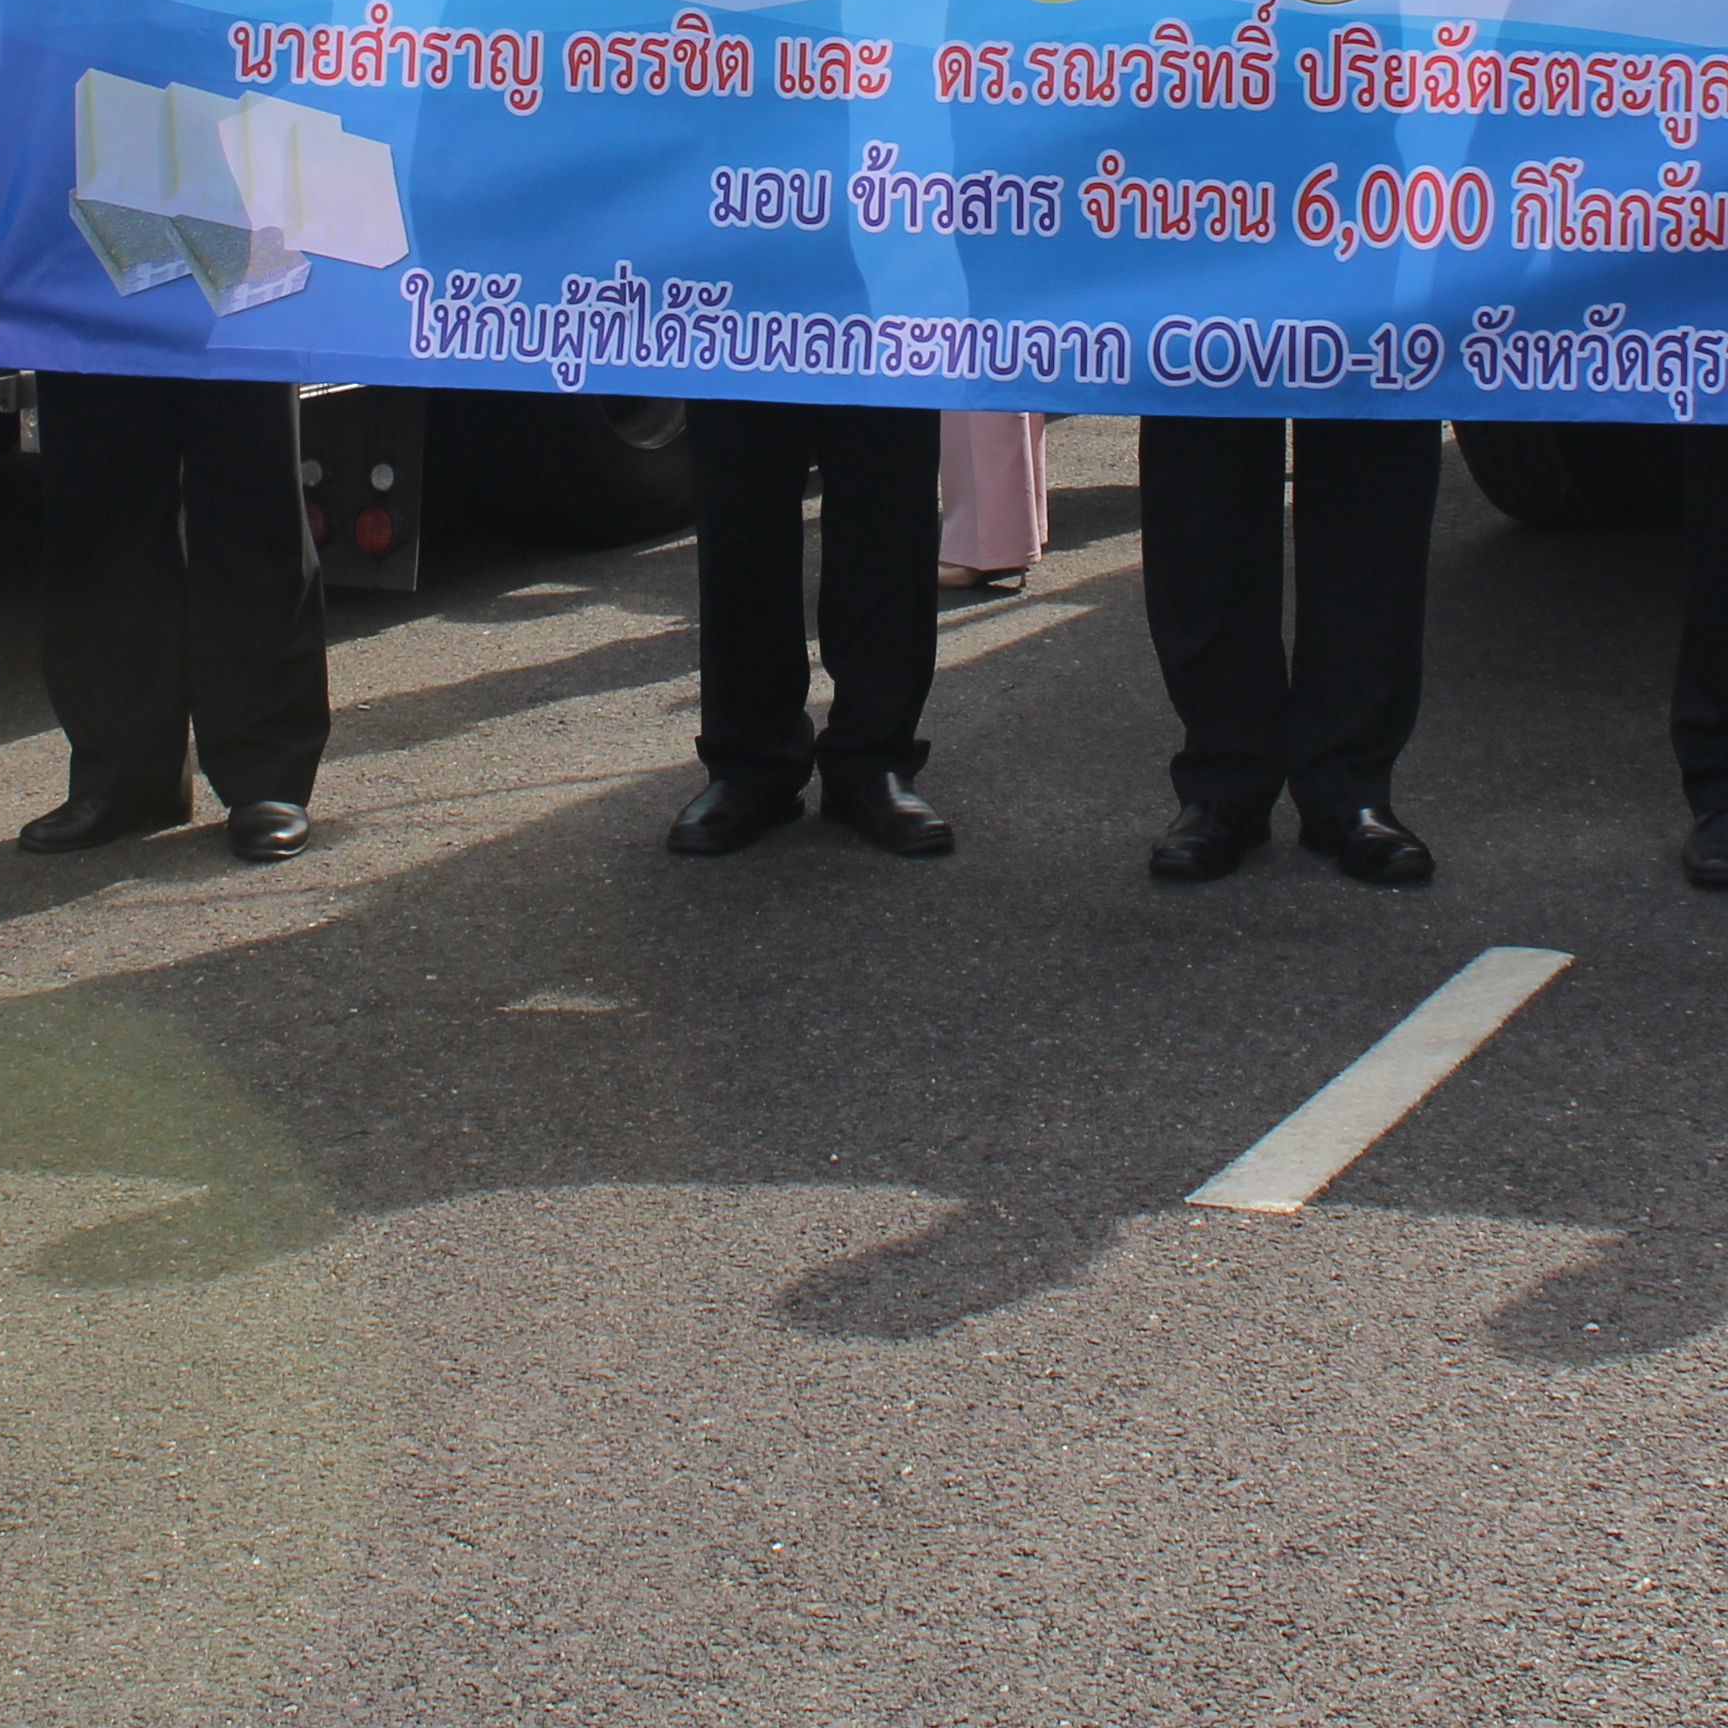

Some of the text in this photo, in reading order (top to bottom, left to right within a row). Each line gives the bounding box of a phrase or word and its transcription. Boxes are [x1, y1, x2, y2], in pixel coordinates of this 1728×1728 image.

[232, 1, 541, 112] นายสำราญ
[567, 11, 751, 93] ครรชิต
[778, 39, 890, 97] และ
[712, 144, 1728, 255] มอบ ข้าวสาร จำนวน 6,000 กิโลกรัม
[404, 264, 1126, 387] ให้กับผู้ที่ได้รับผลกระทบจาก
[1152, 321, 1441, 388] COVID-19
